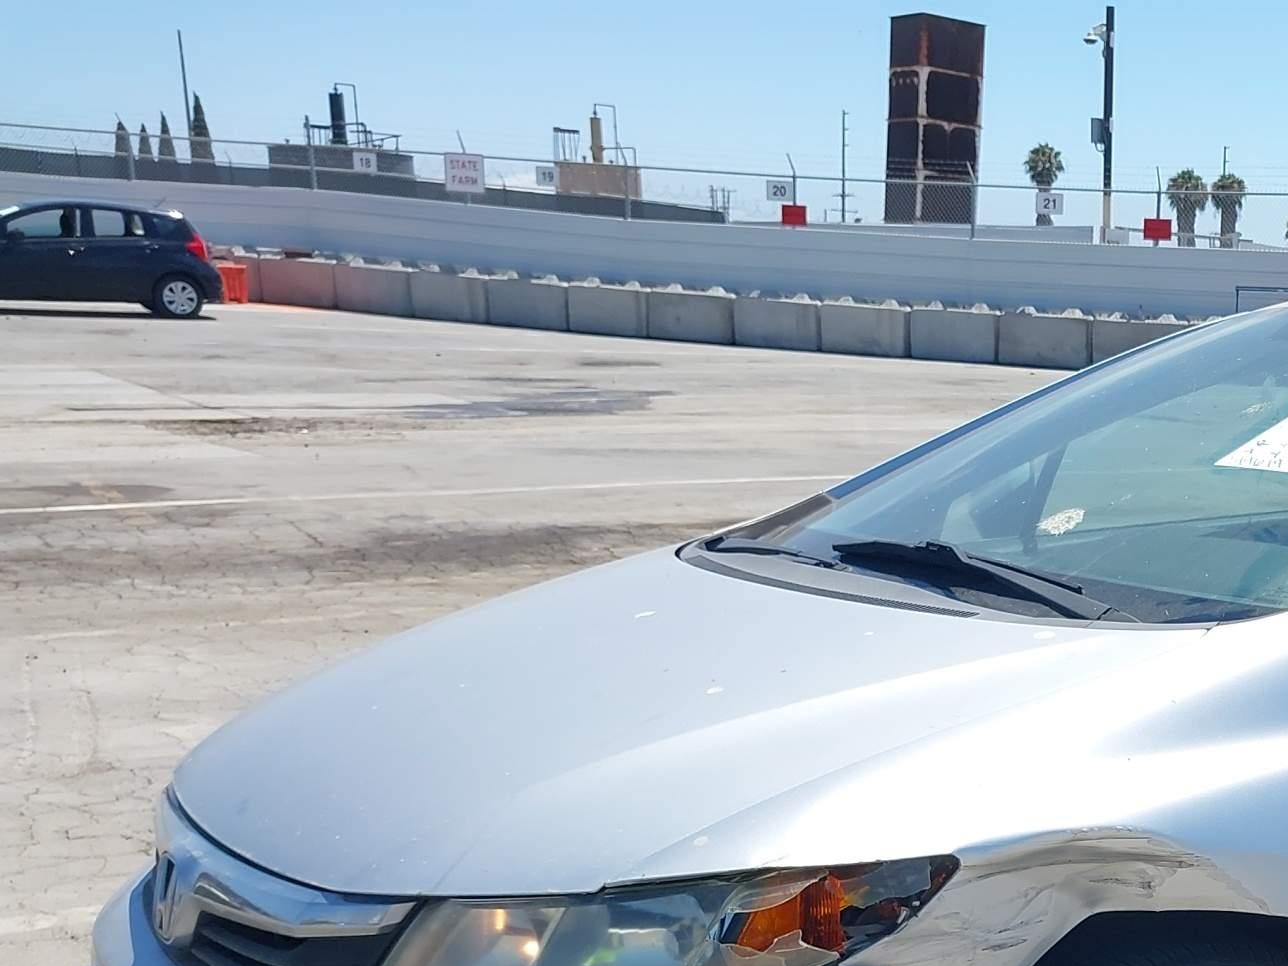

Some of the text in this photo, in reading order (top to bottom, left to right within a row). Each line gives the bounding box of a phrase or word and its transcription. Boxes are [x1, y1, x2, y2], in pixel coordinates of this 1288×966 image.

[450, 159, 478, 172] STATE
[451, 174, 478, 185] FARM
[541, 171, 554, 183] 19
[772, 185, 787, 197] 20
[1043, 198, 1057, 210] 21
